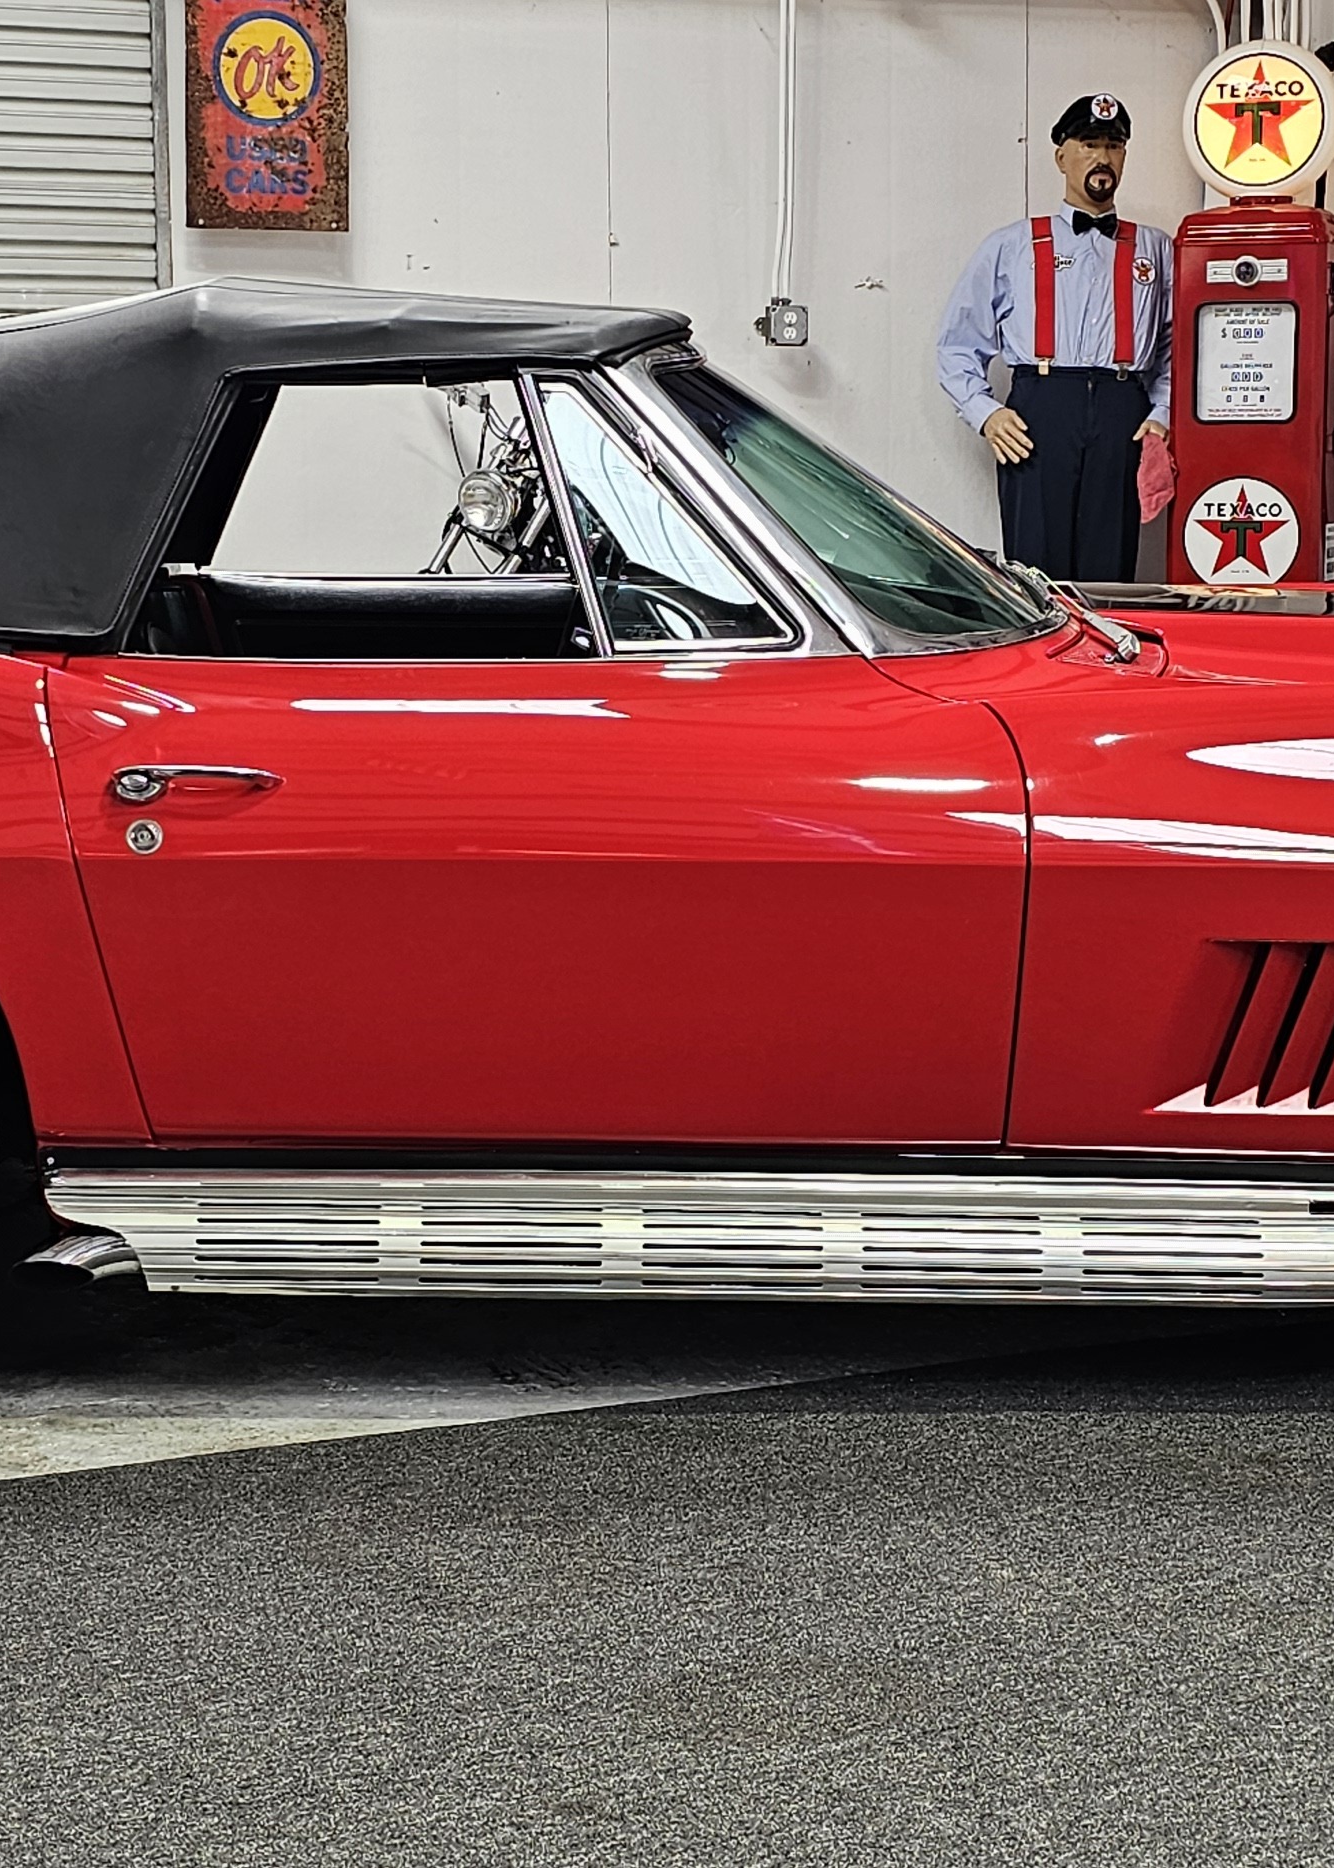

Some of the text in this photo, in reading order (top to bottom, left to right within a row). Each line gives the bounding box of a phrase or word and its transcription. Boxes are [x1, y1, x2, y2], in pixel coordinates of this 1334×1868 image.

[233, 36, 300, 100] OK
[1216, 81, 1304, 99] TEXACO
[224, 167, 310, 195] CARS
[1204, 503, 1283, 517] TEXACO
